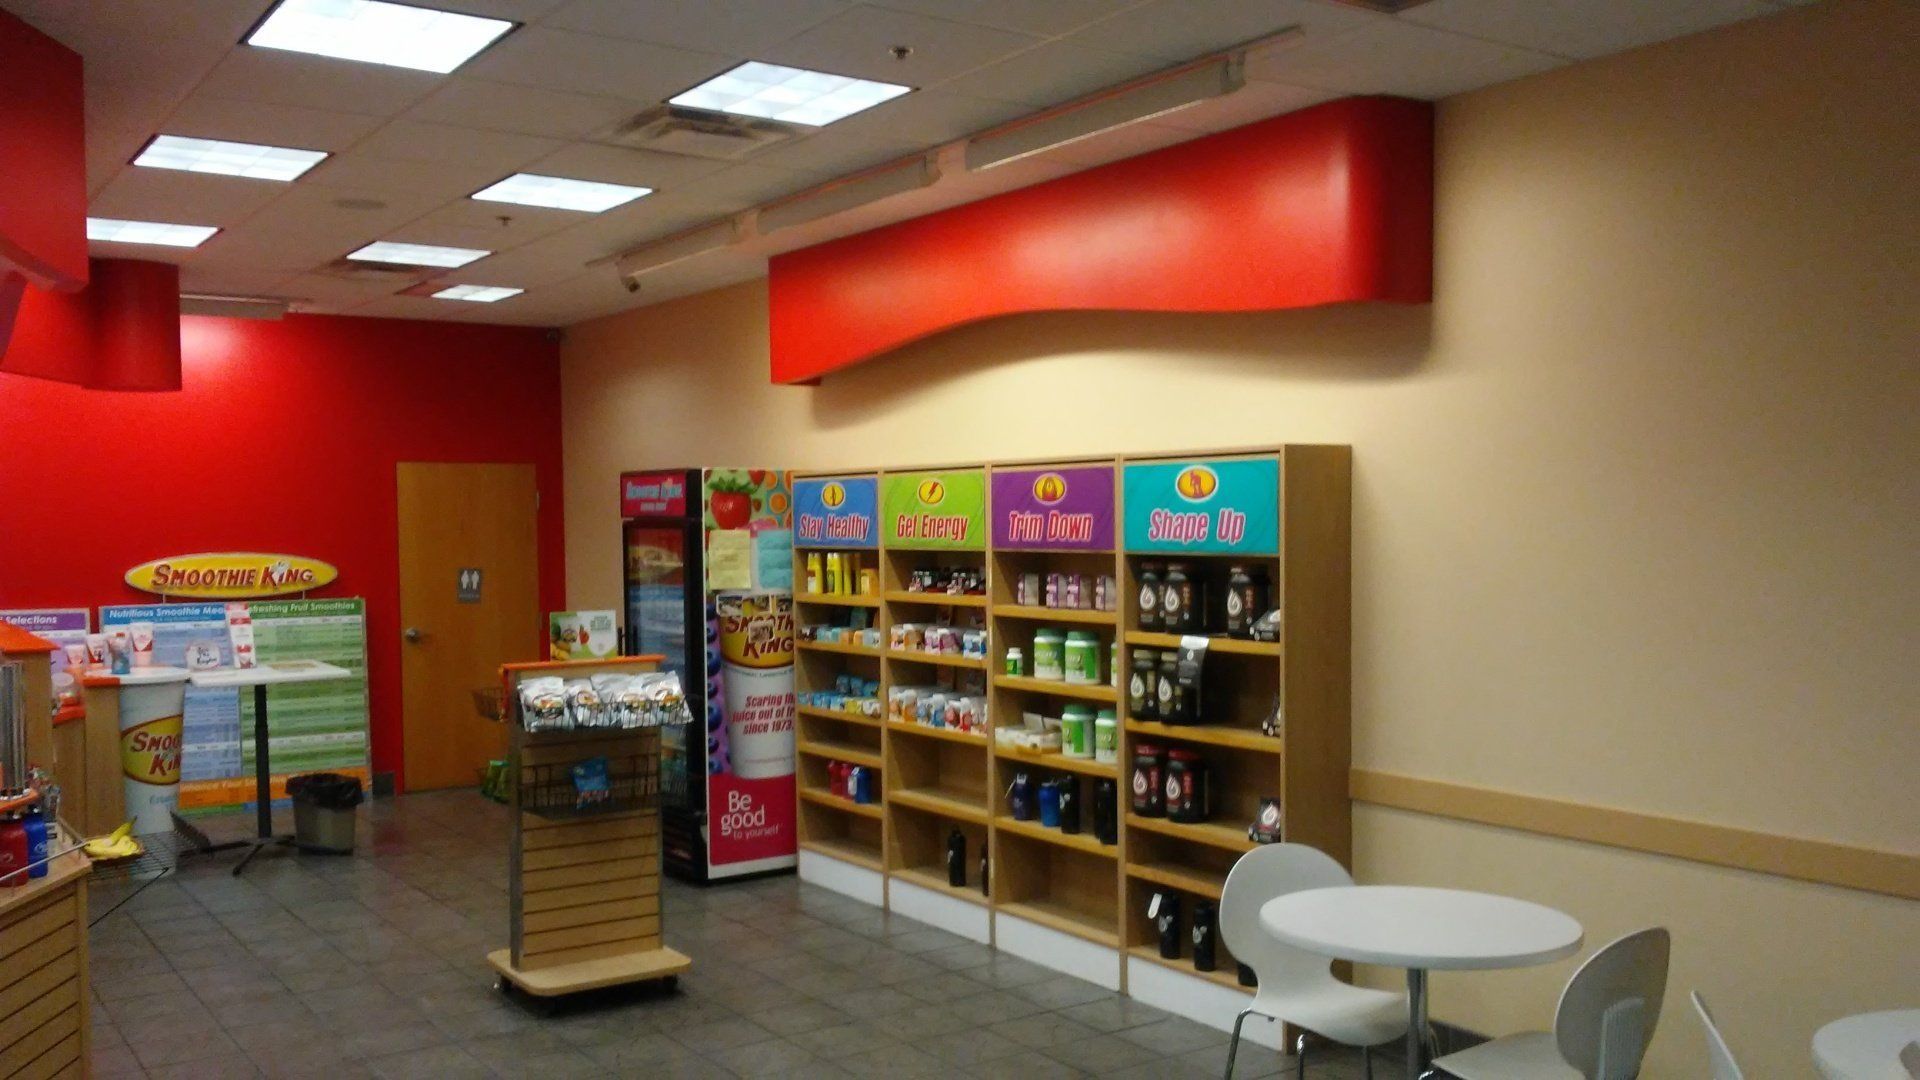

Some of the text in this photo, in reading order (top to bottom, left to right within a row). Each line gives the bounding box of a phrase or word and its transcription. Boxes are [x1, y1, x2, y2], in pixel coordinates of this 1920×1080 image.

[799, 511, 870, 541] Stay Healthy
[897, 514, 968, 541] Get Energy
[1009, 510, 1093, 541] Trim Down
[1149, 508, 1246, 544] Shape Up
[151, 563, 256, 587] SMOOTHIE
[5, 615, 58, 625] Selections
[156, 605, 201, 617] Smoothie
[745, 694, 783, 708] Scaring
[728, 791, 752, 813] Be
[721, 804, 765, 836] good
